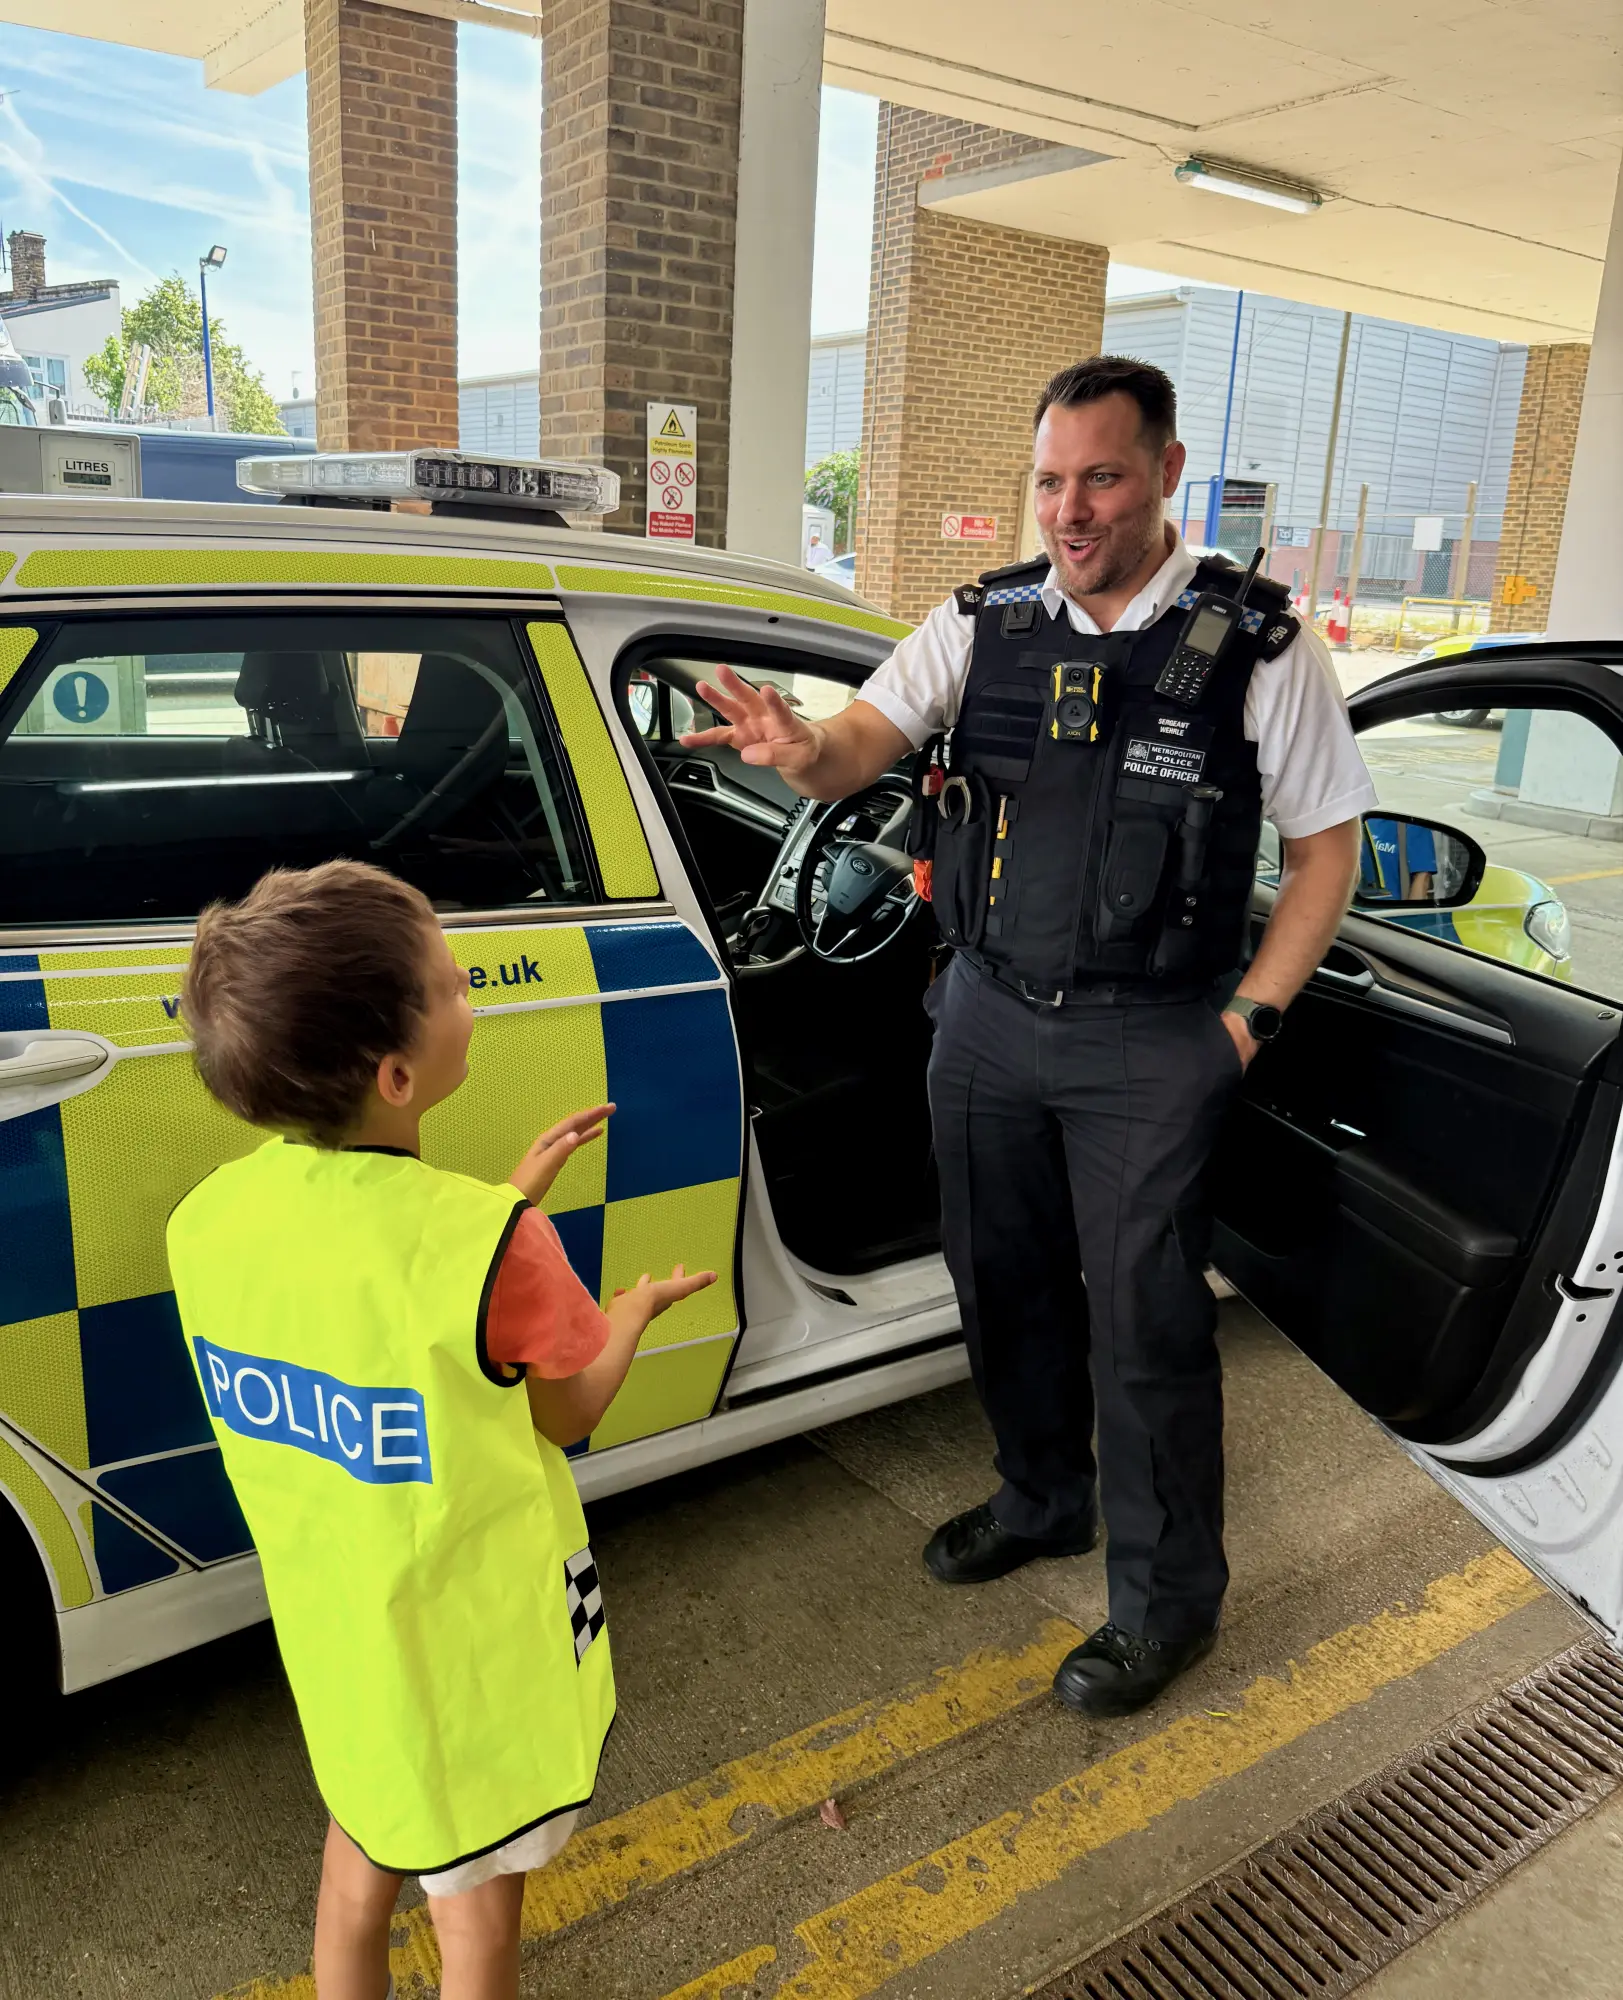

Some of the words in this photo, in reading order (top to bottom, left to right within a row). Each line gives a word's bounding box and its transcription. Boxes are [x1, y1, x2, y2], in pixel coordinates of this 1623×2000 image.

[65, 460, 109, 472] LITRES
[963, 527, 992, 537] Smoking
[1267, 625, 1288, 645] 750
[1158, 718, 1190, 729] SERGEANT
[1160, 726, 1184, 736] WEHRLE
[1151, 746, 1201, 760] METROPOLITAN
[1155, 755, 1193, 767] POLICE
[1123, 761, 1158, 776] POLICE
[1159, 768, 1200, 783] OFFICER
[206, 1350, 423, 1467] POLICE
